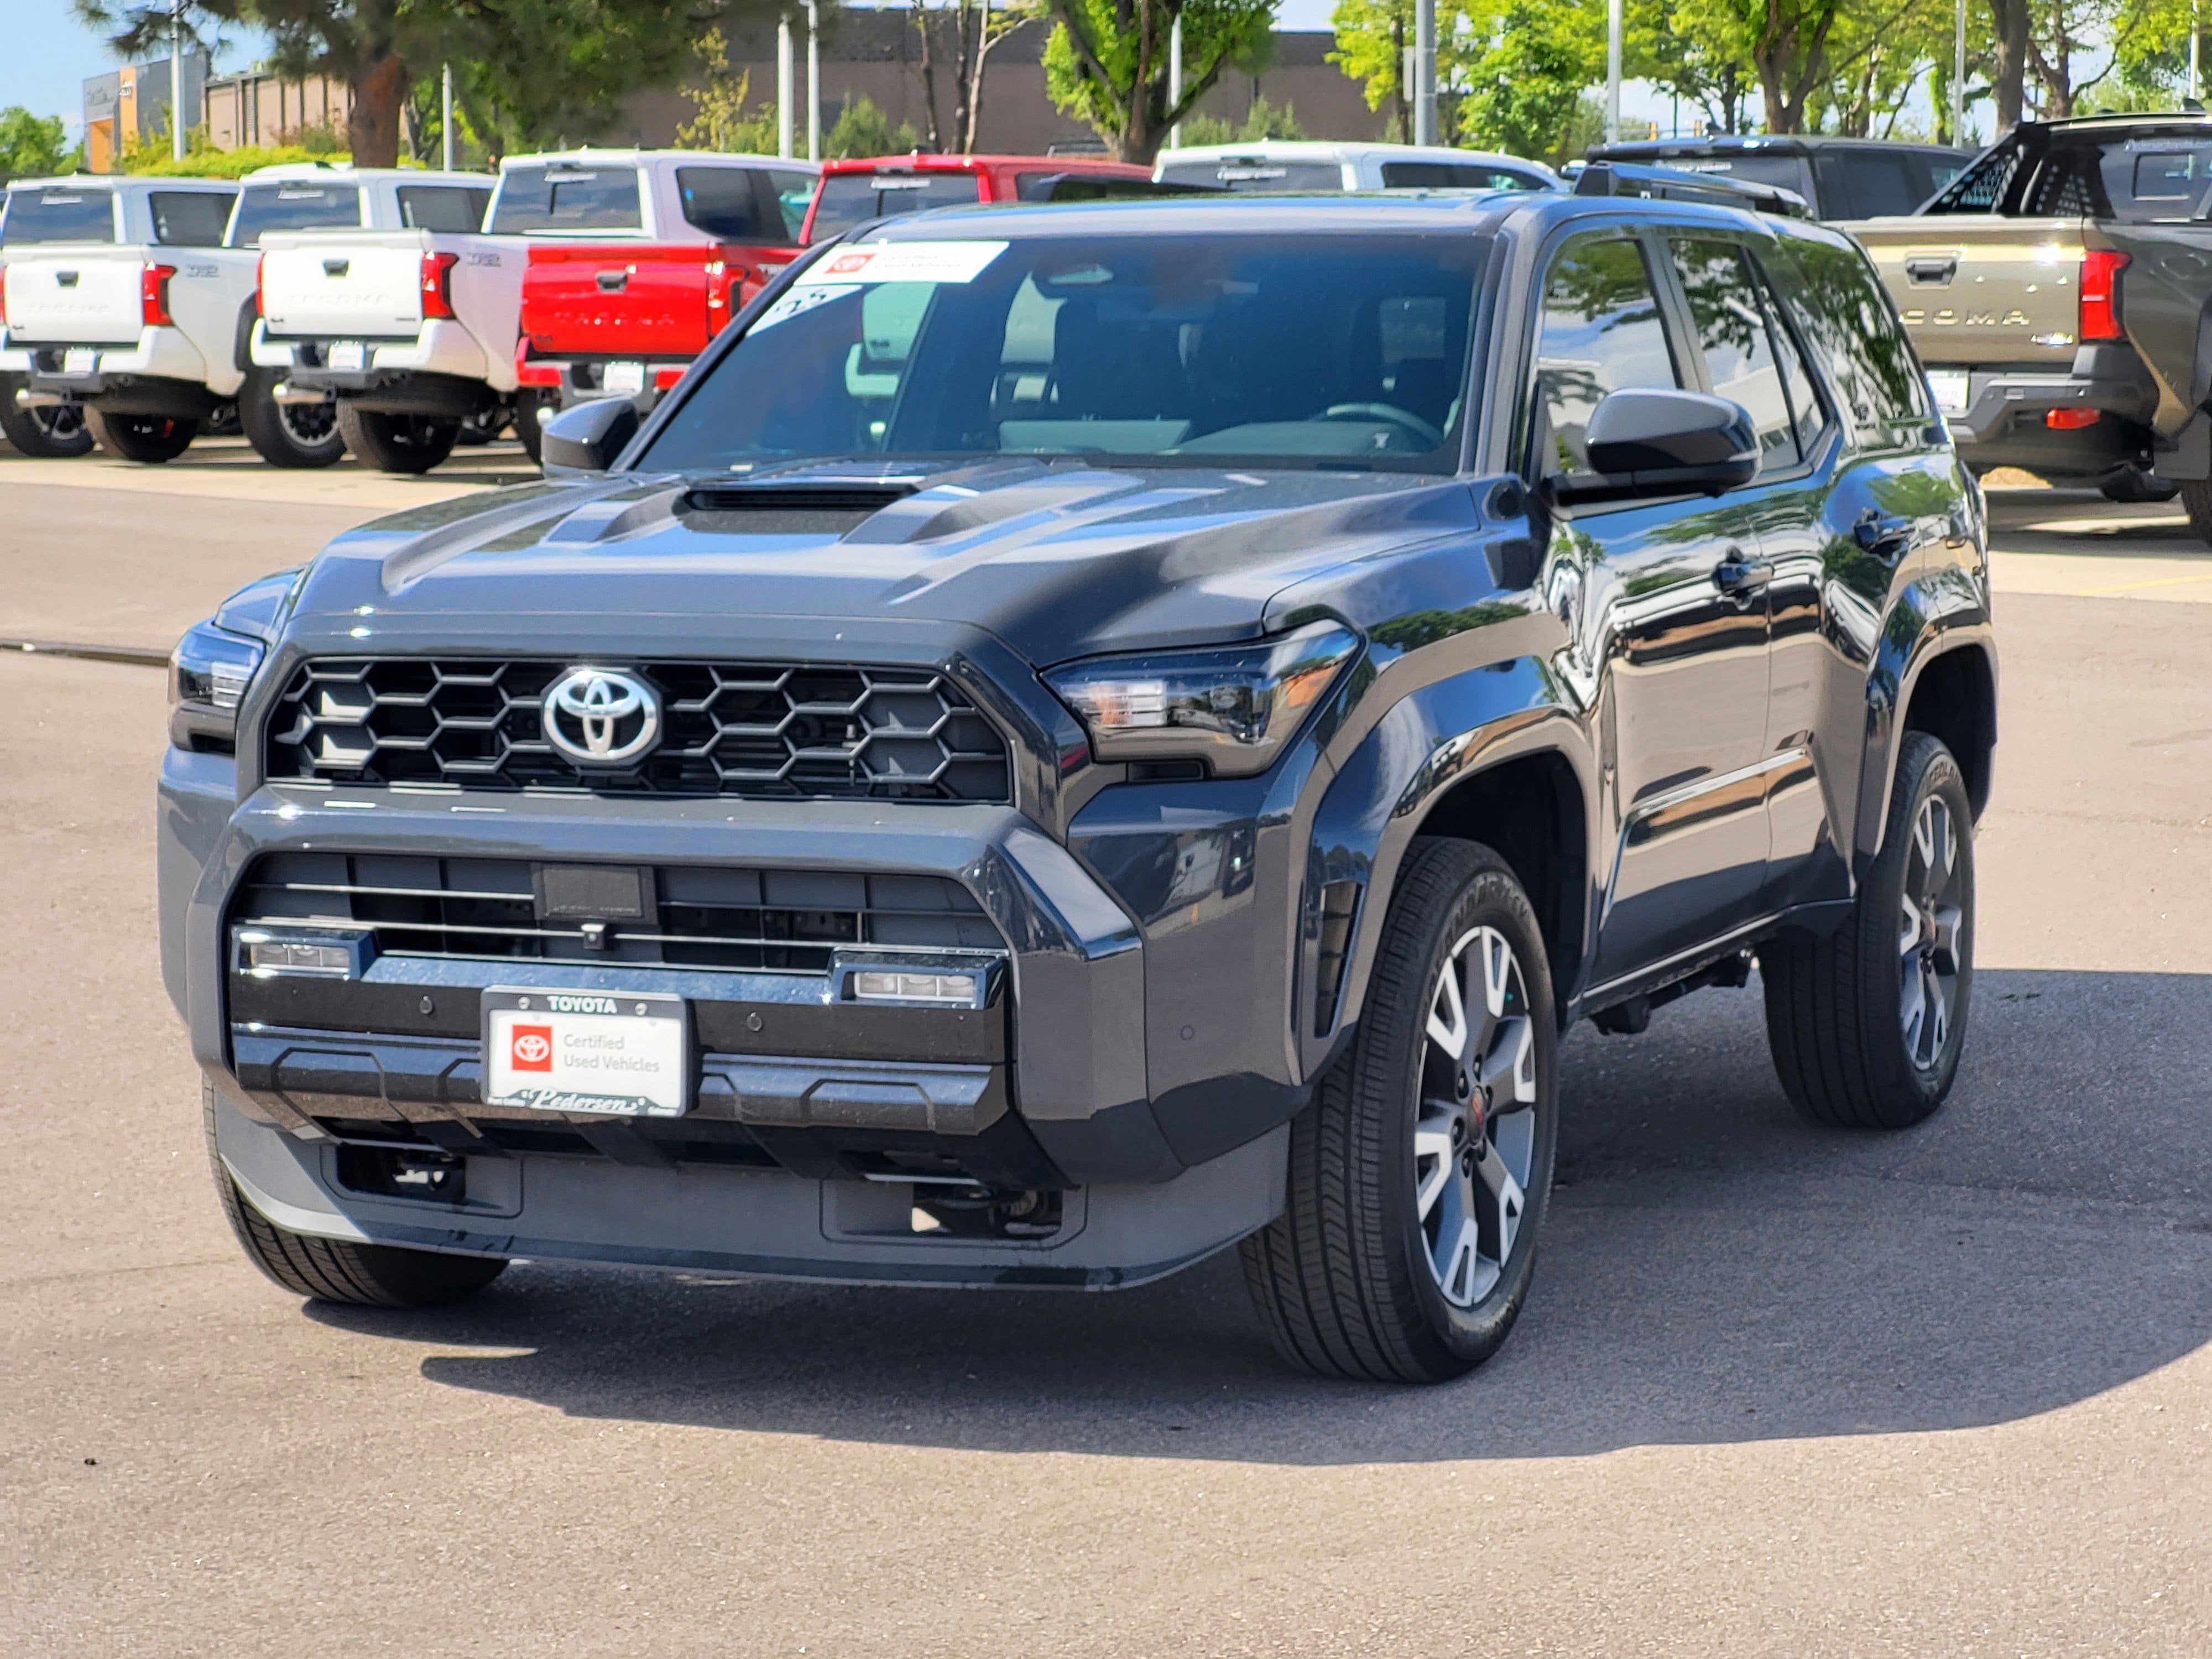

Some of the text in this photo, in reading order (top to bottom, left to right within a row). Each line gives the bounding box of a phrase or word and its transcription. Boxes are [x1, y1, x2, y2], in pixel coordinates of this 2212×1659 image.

[547, 996, 618, 1014] TOYOTA
[563, 1033, 625, 1050] Certified
[564, 1054, 661, 1073] Used Vehicles
[531, 1089, 639, 1113] Pedersen
